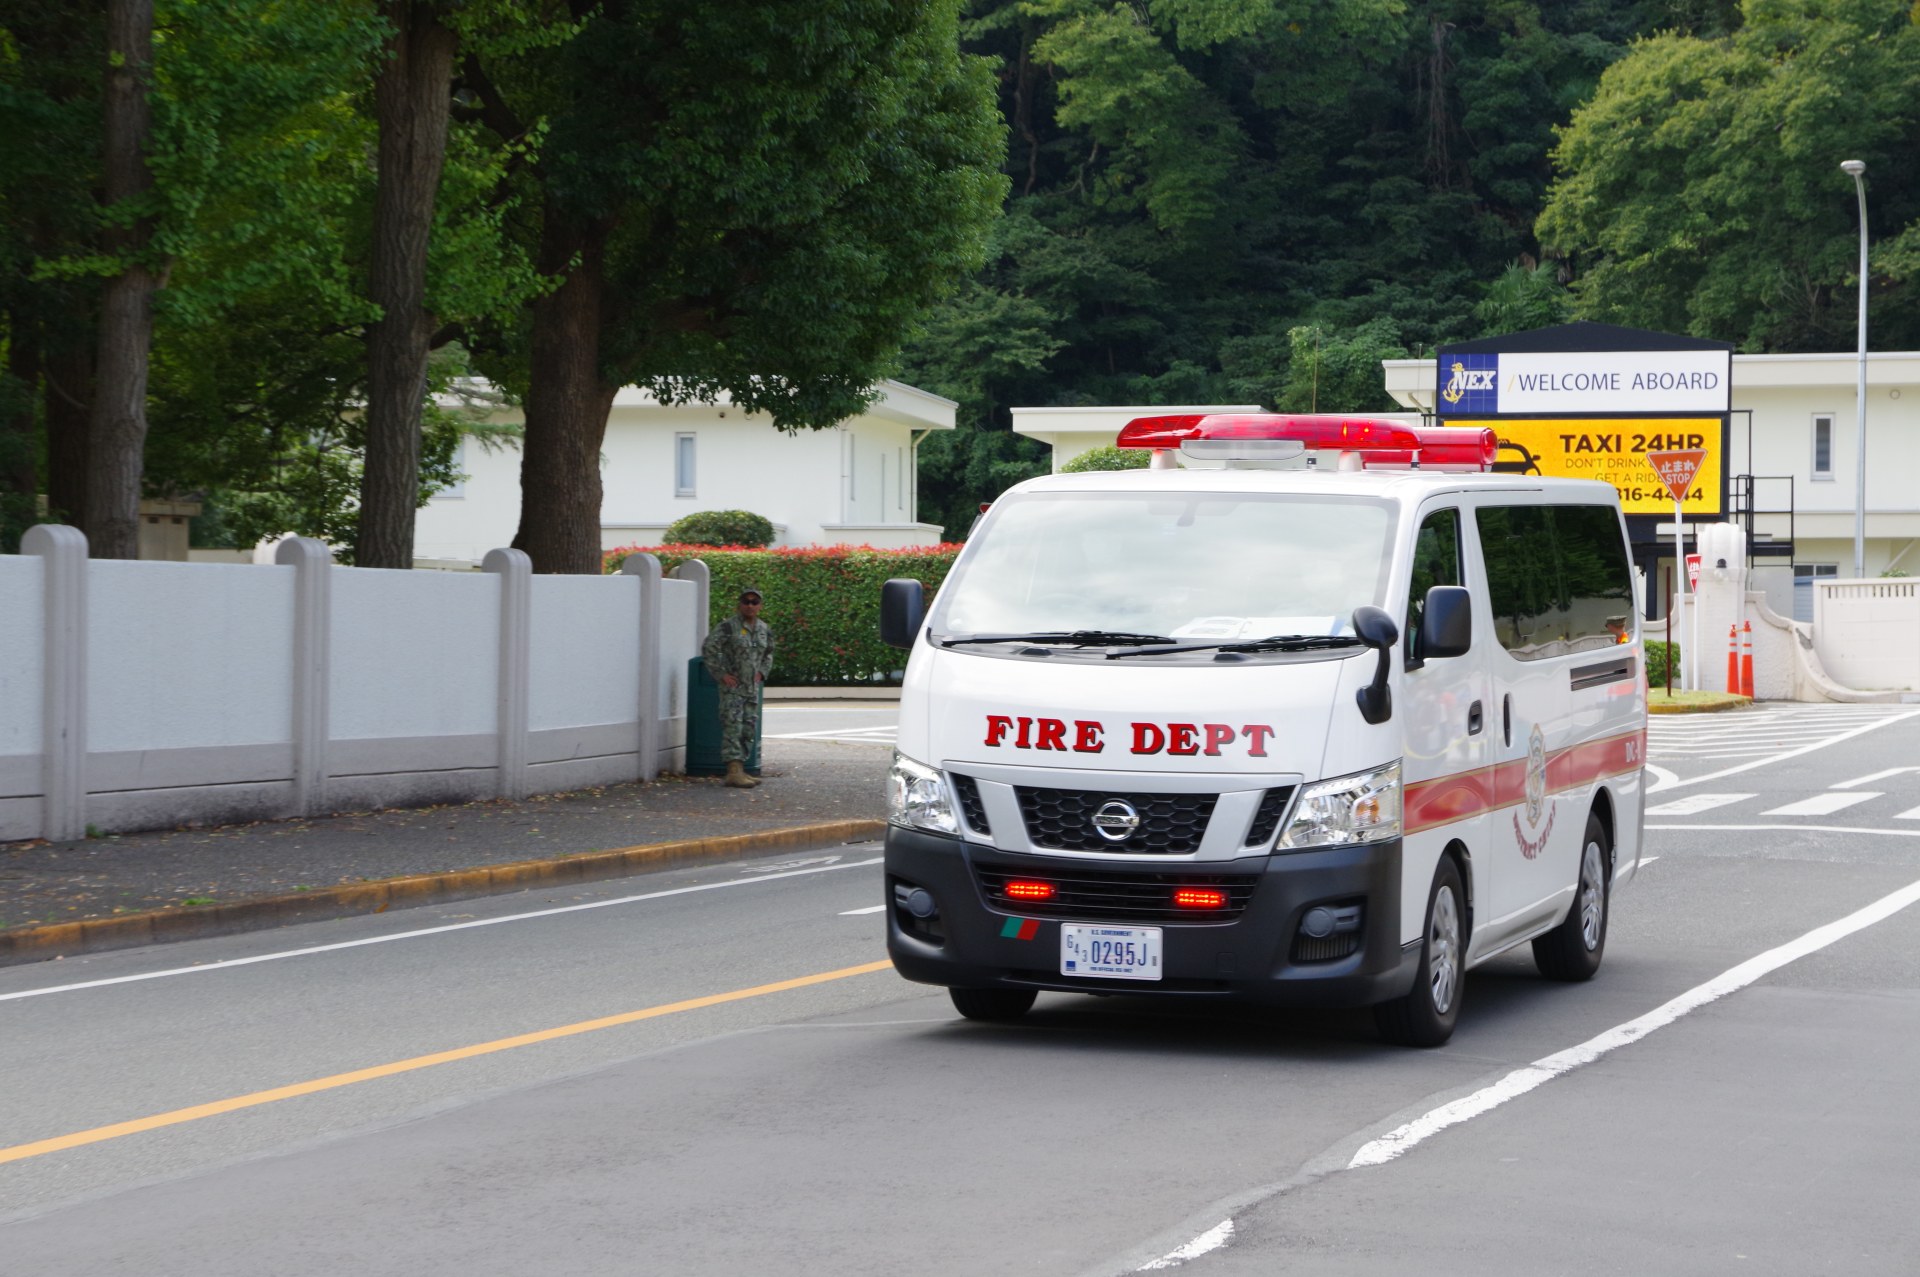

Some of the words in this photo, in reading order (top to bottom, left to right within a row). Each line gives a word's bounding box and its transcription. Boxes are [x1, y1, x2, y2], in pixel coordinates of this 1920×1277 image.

[1452, 369, 1497, 390] NEX
[1518, 373, 1621, 391] WELCOME
[1631, 372, 1719, 390] ABOARD
[1559, 434, 1622, 453] TAXI
[1631, 434, 1705, 452] 24HR
[1565, 458, 1603, 469] DON'T
[1607, 458, 1646, 468] DRINK
[1660, 460, 1696, 473] 止まれ
[1595, 473, 1618, 483] GET
[1623, 473, 1632, 483] A
[1666, 472, 1691, 485] STOP
[984, 715, 1105, 753] FIRE
[1130, 722, 1275, 757] DEPT
[1092, 941, 1147, 966] 0295J
